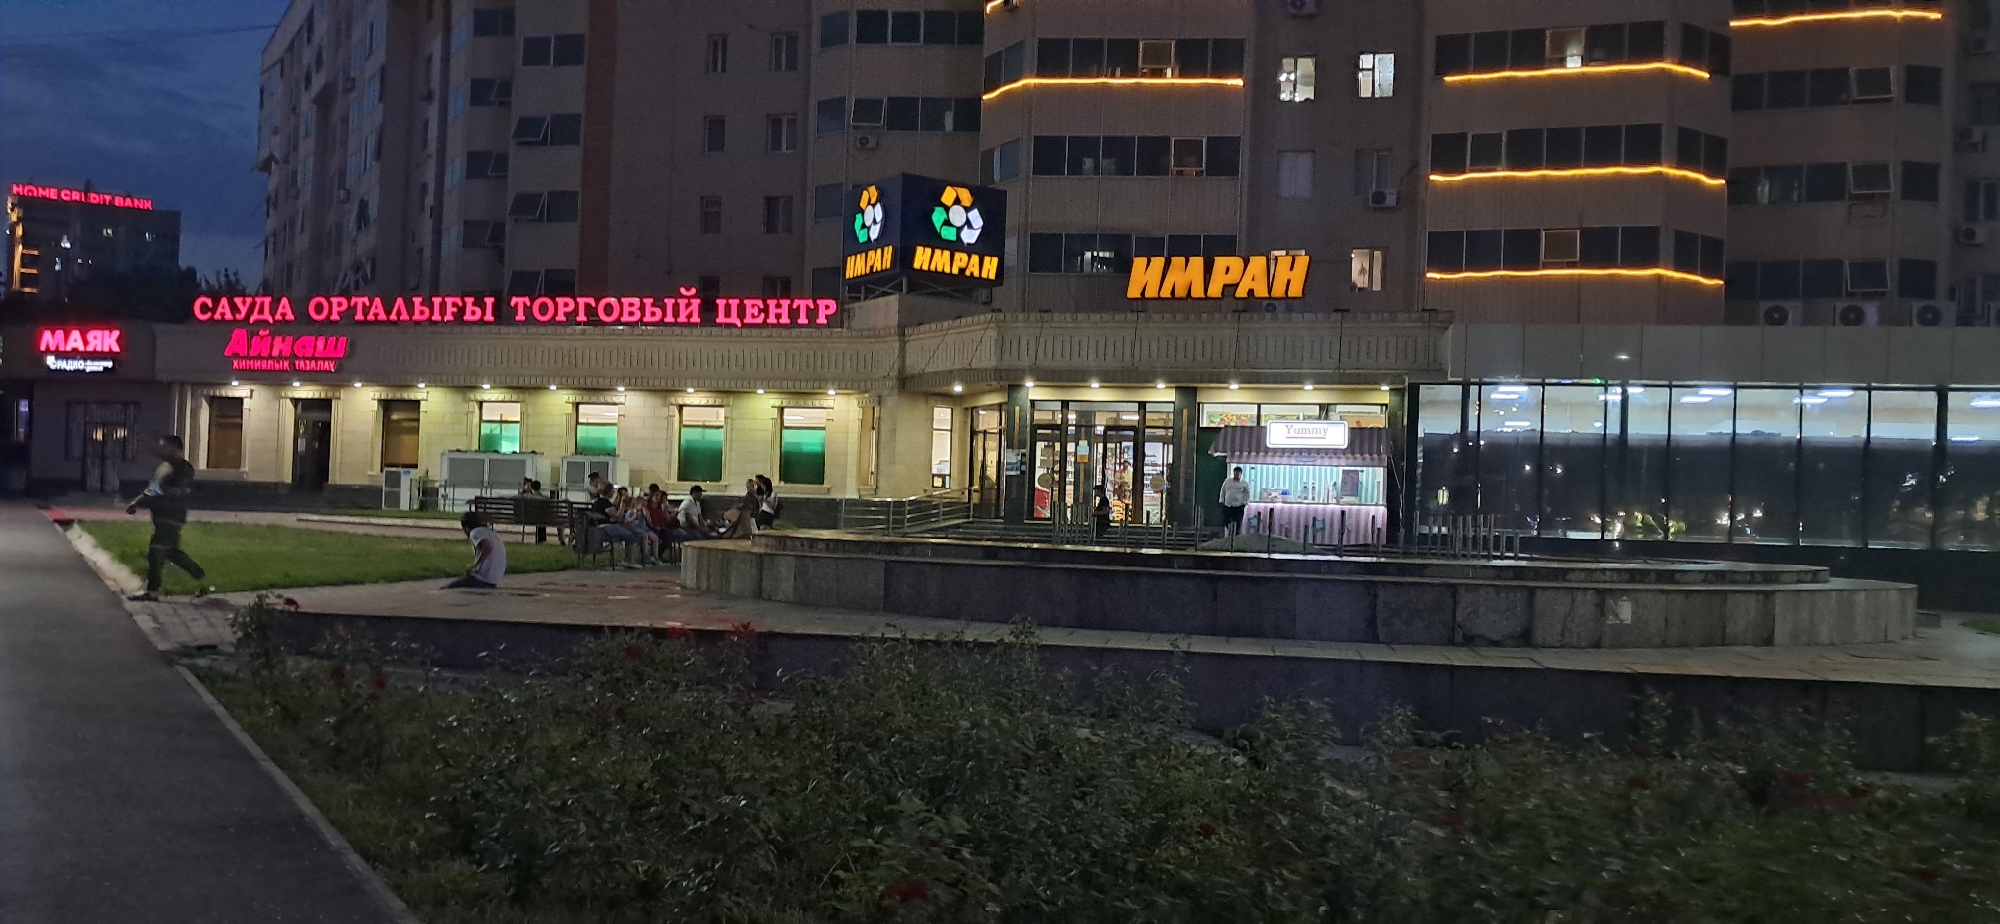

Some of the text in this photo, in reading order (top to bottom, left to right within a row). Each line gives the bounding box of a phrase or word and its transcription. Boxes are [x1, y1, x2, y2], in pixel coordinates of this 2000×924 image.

[12, 184, 58, 200] HOME
[114, 195, 153, 210] BANK
[845, 244, 894, 280] ИМРАН
[912, 245, 999, 280] ИМРАН
[1126, 255, 1311, 299] ИМРАН
[193, 286, 837, 328] САУДА ОРТАЛЫҒЫ ТОРГОВЫЙ ЦЕНТР
[39, 329, 121, 353] МАЯК
[223, 328, 348, 358] Айнаш
[1285, 424, 1329, 437] Yummy
